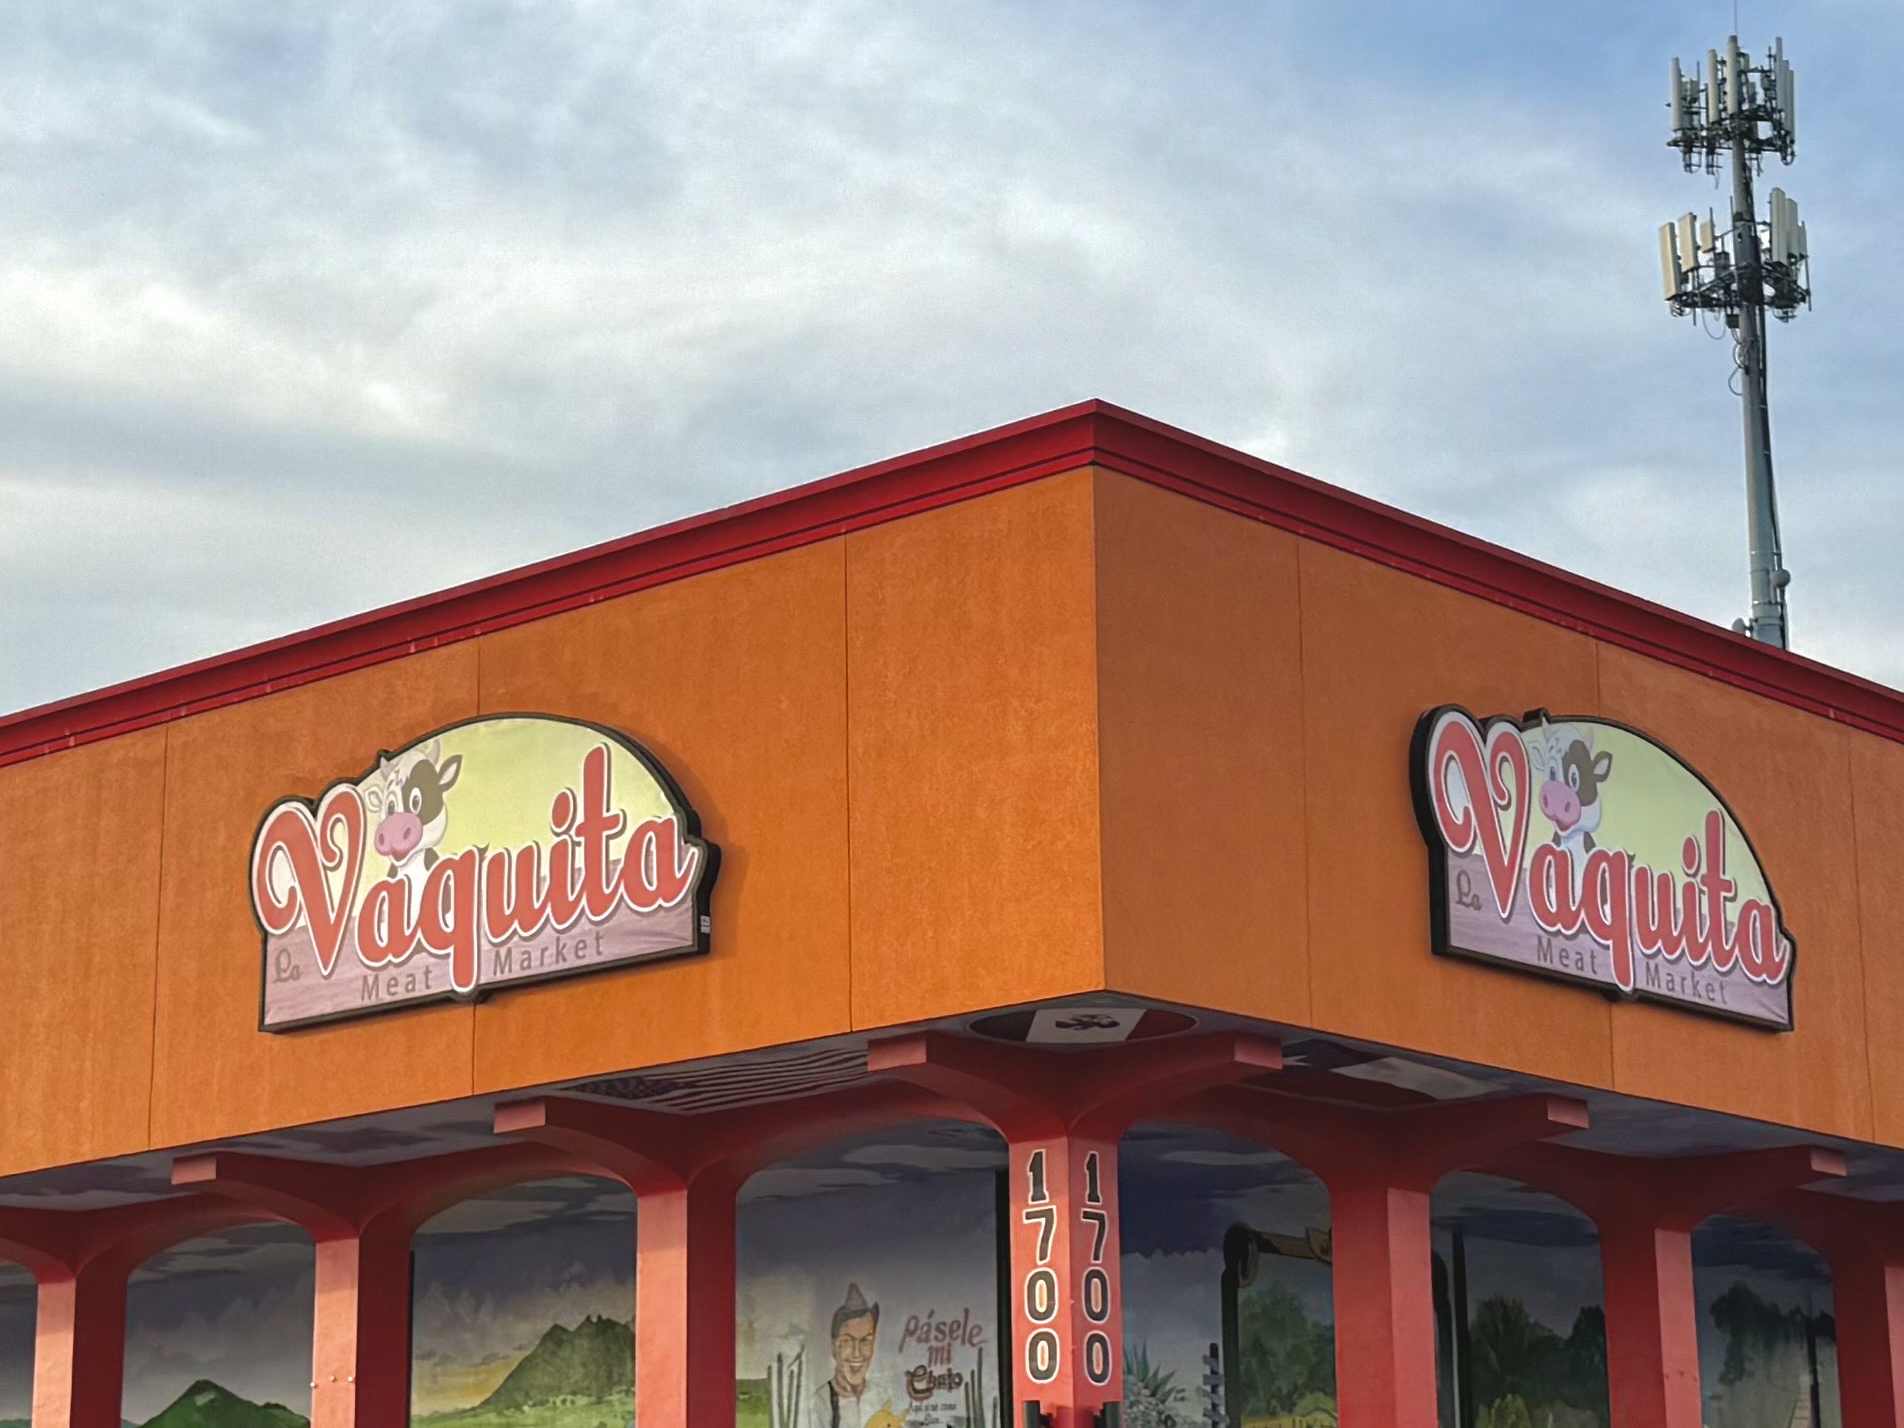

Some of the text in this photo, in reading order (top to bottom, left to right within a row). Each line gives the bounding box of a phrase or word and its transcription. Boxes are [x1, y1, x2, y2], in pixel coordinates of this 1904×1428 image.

[252, 742, 698, 993] Vaquita
[1429, 711, 1791, 991] Vaquita
[1455, 871, 1482, 911] La
[273, 948, 302, 985] La
[361, 931, 605, 1002] Meat Market
[1536, 935, 1729, 1006] Meat Market
[1023, 1148, 1060, 1384] 1700
[1081, 1151, 1113, 1387] 1700
[898, 1307, 991, 1354] Pásele
